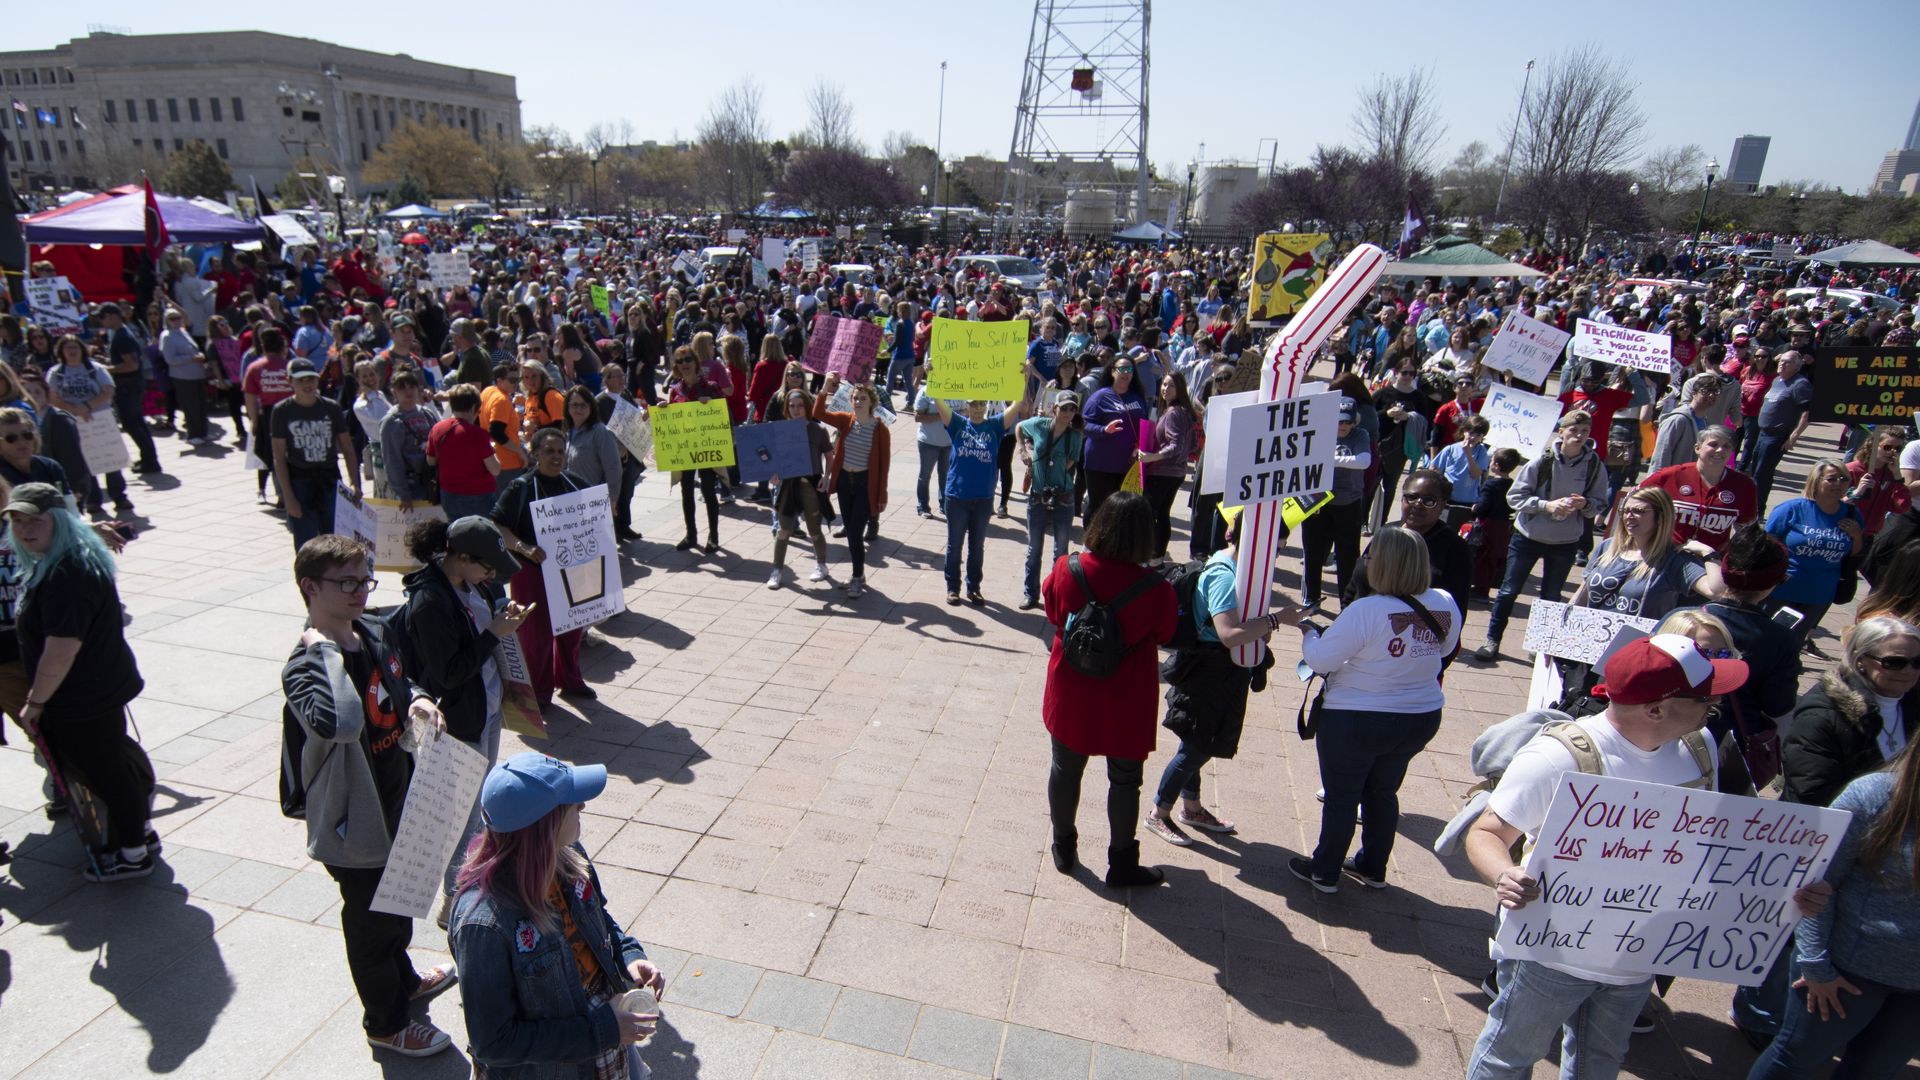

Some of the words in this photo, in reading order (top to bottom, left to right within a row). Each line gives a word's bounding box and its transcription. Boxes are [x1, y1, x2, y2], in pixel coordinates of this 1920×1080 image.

[937, 322, 958, 352] Can
[966, 329, 981, 348] You
[985, 331, 1008, 348] Sell
[1592, 338, 1603, 346] I
[1610, 341, 1647, 353] WOULD
[1652, 347, 1669, 355] DO
[935, 355, 978, 371] Private
[988, 354, 1008, 370] Jet
[1598, 348, 1615, 356] IT
[1620, 352, 1640, 361] ALL
[1644, 355, 1669, 365] OVER
[1835, 357, 1859, 369] WE
[1870, 356, 1908, 369] ARE
[928, 373, 941, 389] for
[943, 378, 965, 391] Extra
[1491, 392, 1521, 415] Fund
[1522, 409, 1538, 419] our
[1880, 391, 1905, 403] OF
[672, 410, 683, 420] not
[1267, 399, 1311, 432] THE
[655, 426, 666, 439] My
[683, 423, 697, 433] have
[677, 440, 689, 454] just
[701, 436, 728, 447] citizen
[1254, 430, 1316, 465] LAST
[304, 447, 327, 462] LIE
[670, 455, 684, 465] who
[689, 450, 723, 464] VOTES
[1239, 463, 1324, 501] STRAW
[536, 503, 563, 520] Make
[565, 505, 576, 514] us
[576, 503, 587, 516] go
[1672, 506, 1738, 531] TRON
[541, 527, 547, 536] A
[548, 525, 561, 534] few
[562, 521, 579, 531] more
[580, 515, 598, 528] drops
[556, 537, 568, 545] the
[1807, 538, 1823, 548] we
[1826, 541, 1845, 551] are
[1589, 572, 1620, 590] DO
[574, 616, 590, 627] here
[593, 613, 600, 621] to
[1540, 606, 1551, 626] I
[1562, 616, 1597, 633] have
[1415, 629, 1437, 643] HO
[1545, 630, 1567, 655] to
[501, 634, 525, 681] EDUCATIO
[1556, 782, 1661, 847] You've
[1672, 795, 1730, 839] been
[1743, 807, 1829, 865] telling
[1559, 836, 1587, 859] us
[1601, 837, 1652, 862] what
[1662, 840, 1683, 865] to
[1539, 871, 1593, 908] Now
[1602, 884, 1663, 909] we'll
[1678, 888, 1718, 911] tell
[1516, 918, 1593, 951] what
[1615, 920, 1646, 953] to
[1652, 921, 1792, 975] PASS!
